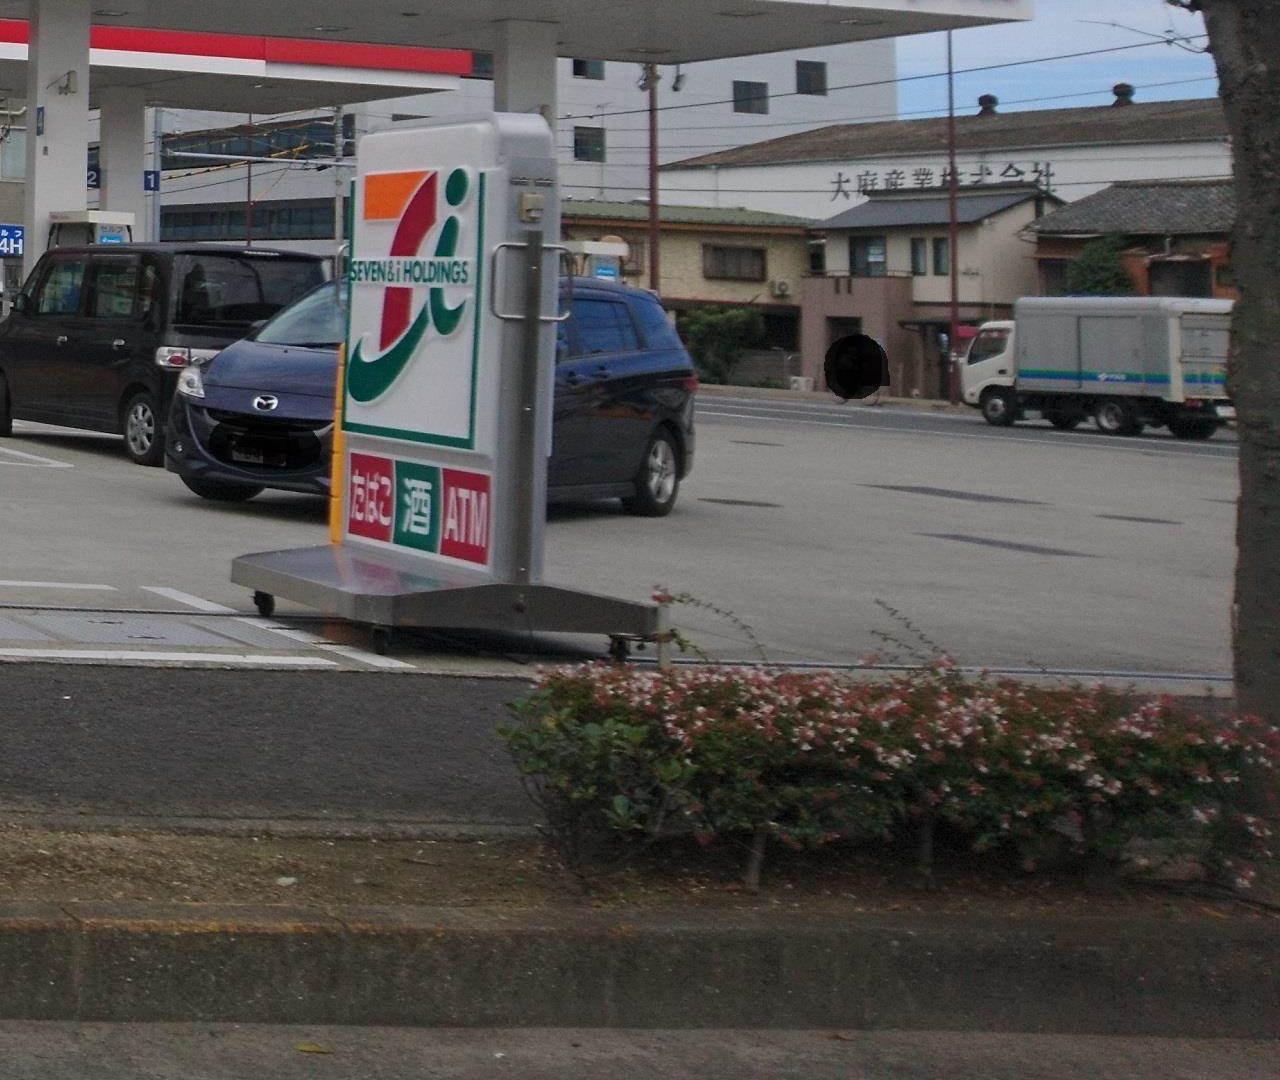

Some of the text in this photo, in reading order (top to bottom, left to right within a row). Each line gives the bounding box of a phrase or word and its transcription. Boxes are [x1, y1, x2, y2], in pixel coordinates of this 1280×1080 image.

[87, 171, 97, 185] 2
[147, 173, 155, 188] 1
[403, 260, 469, 283] HOLDINGS
[351, 469, 488, 548] たばこ 酒 ATM
